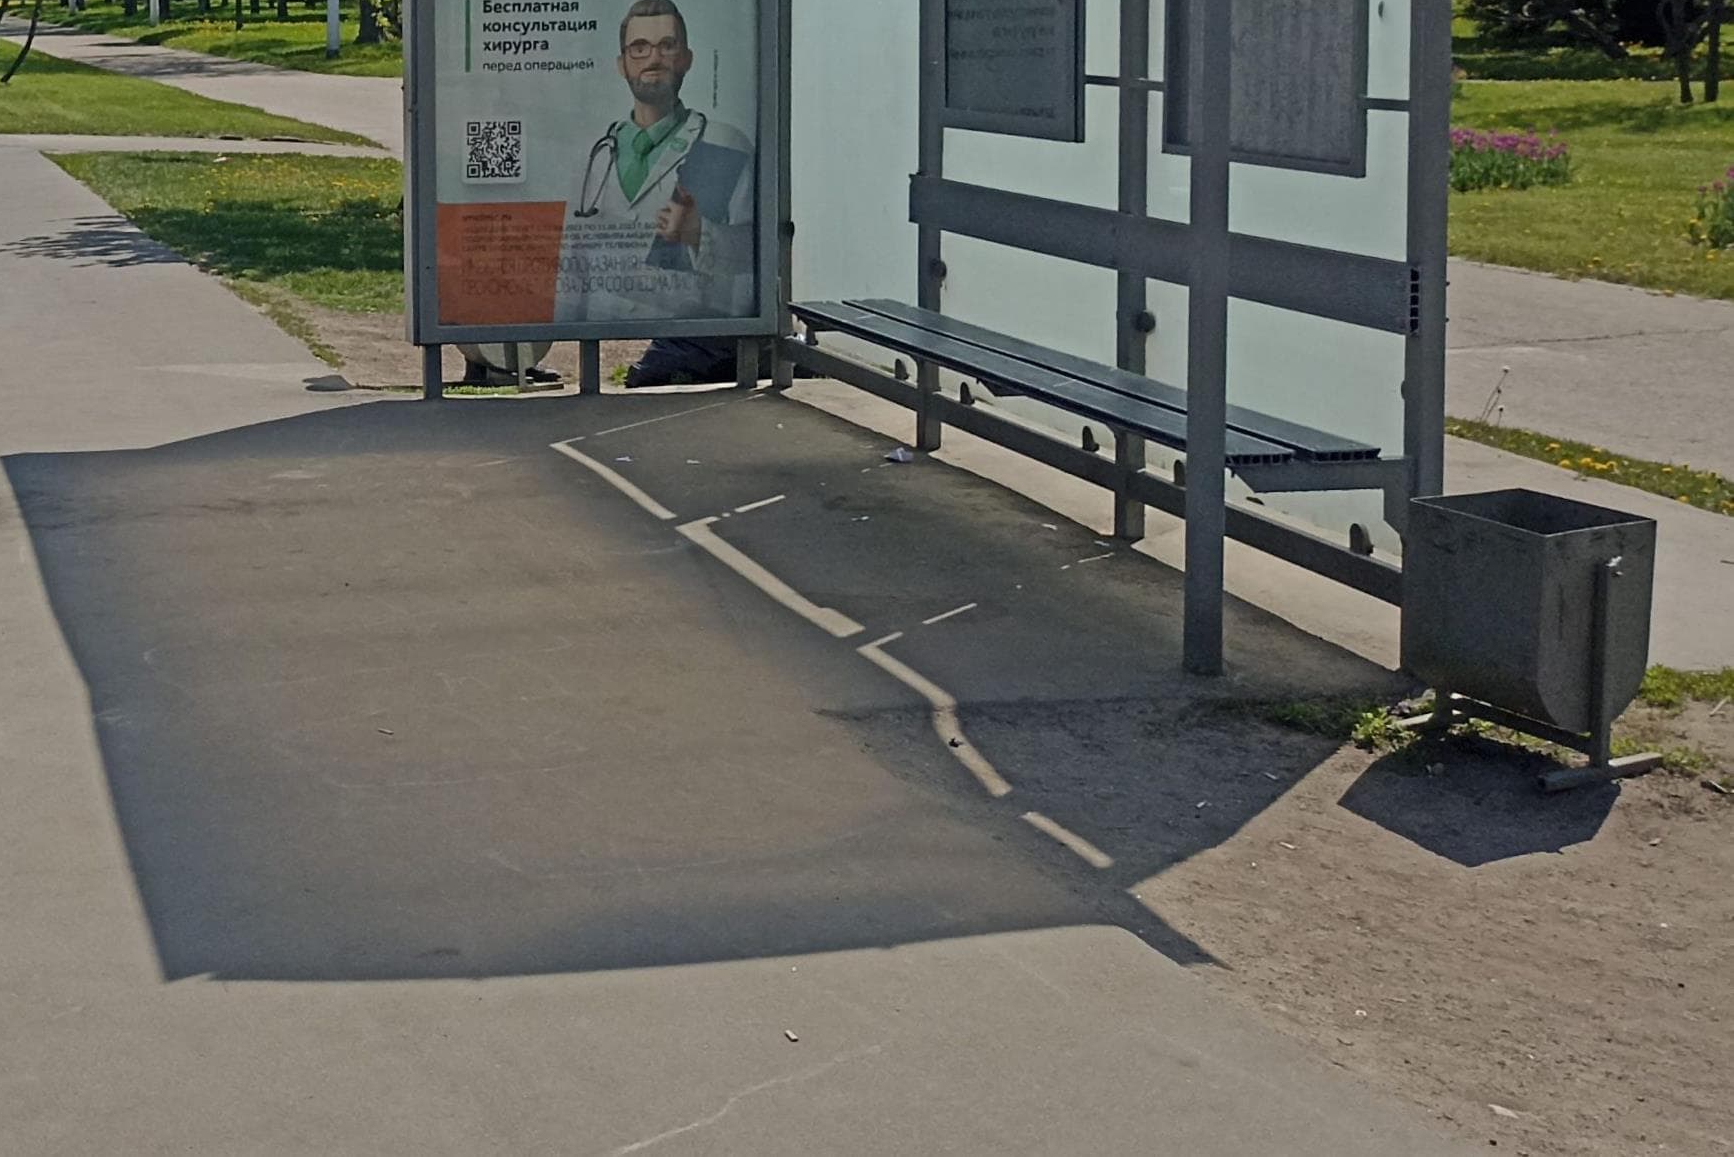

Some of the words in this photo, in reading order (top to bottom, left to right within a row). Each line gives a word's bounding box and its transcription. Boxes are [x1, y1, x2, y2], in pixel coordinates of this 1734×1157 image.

[482, 0, 580, 14] Бесплатная
[482, 20, 598, 36] консультация
[482, 40, 550, 55] хирурга
[482, 62, 522, 73] перед
[524, 58, 594, 72] операцией
